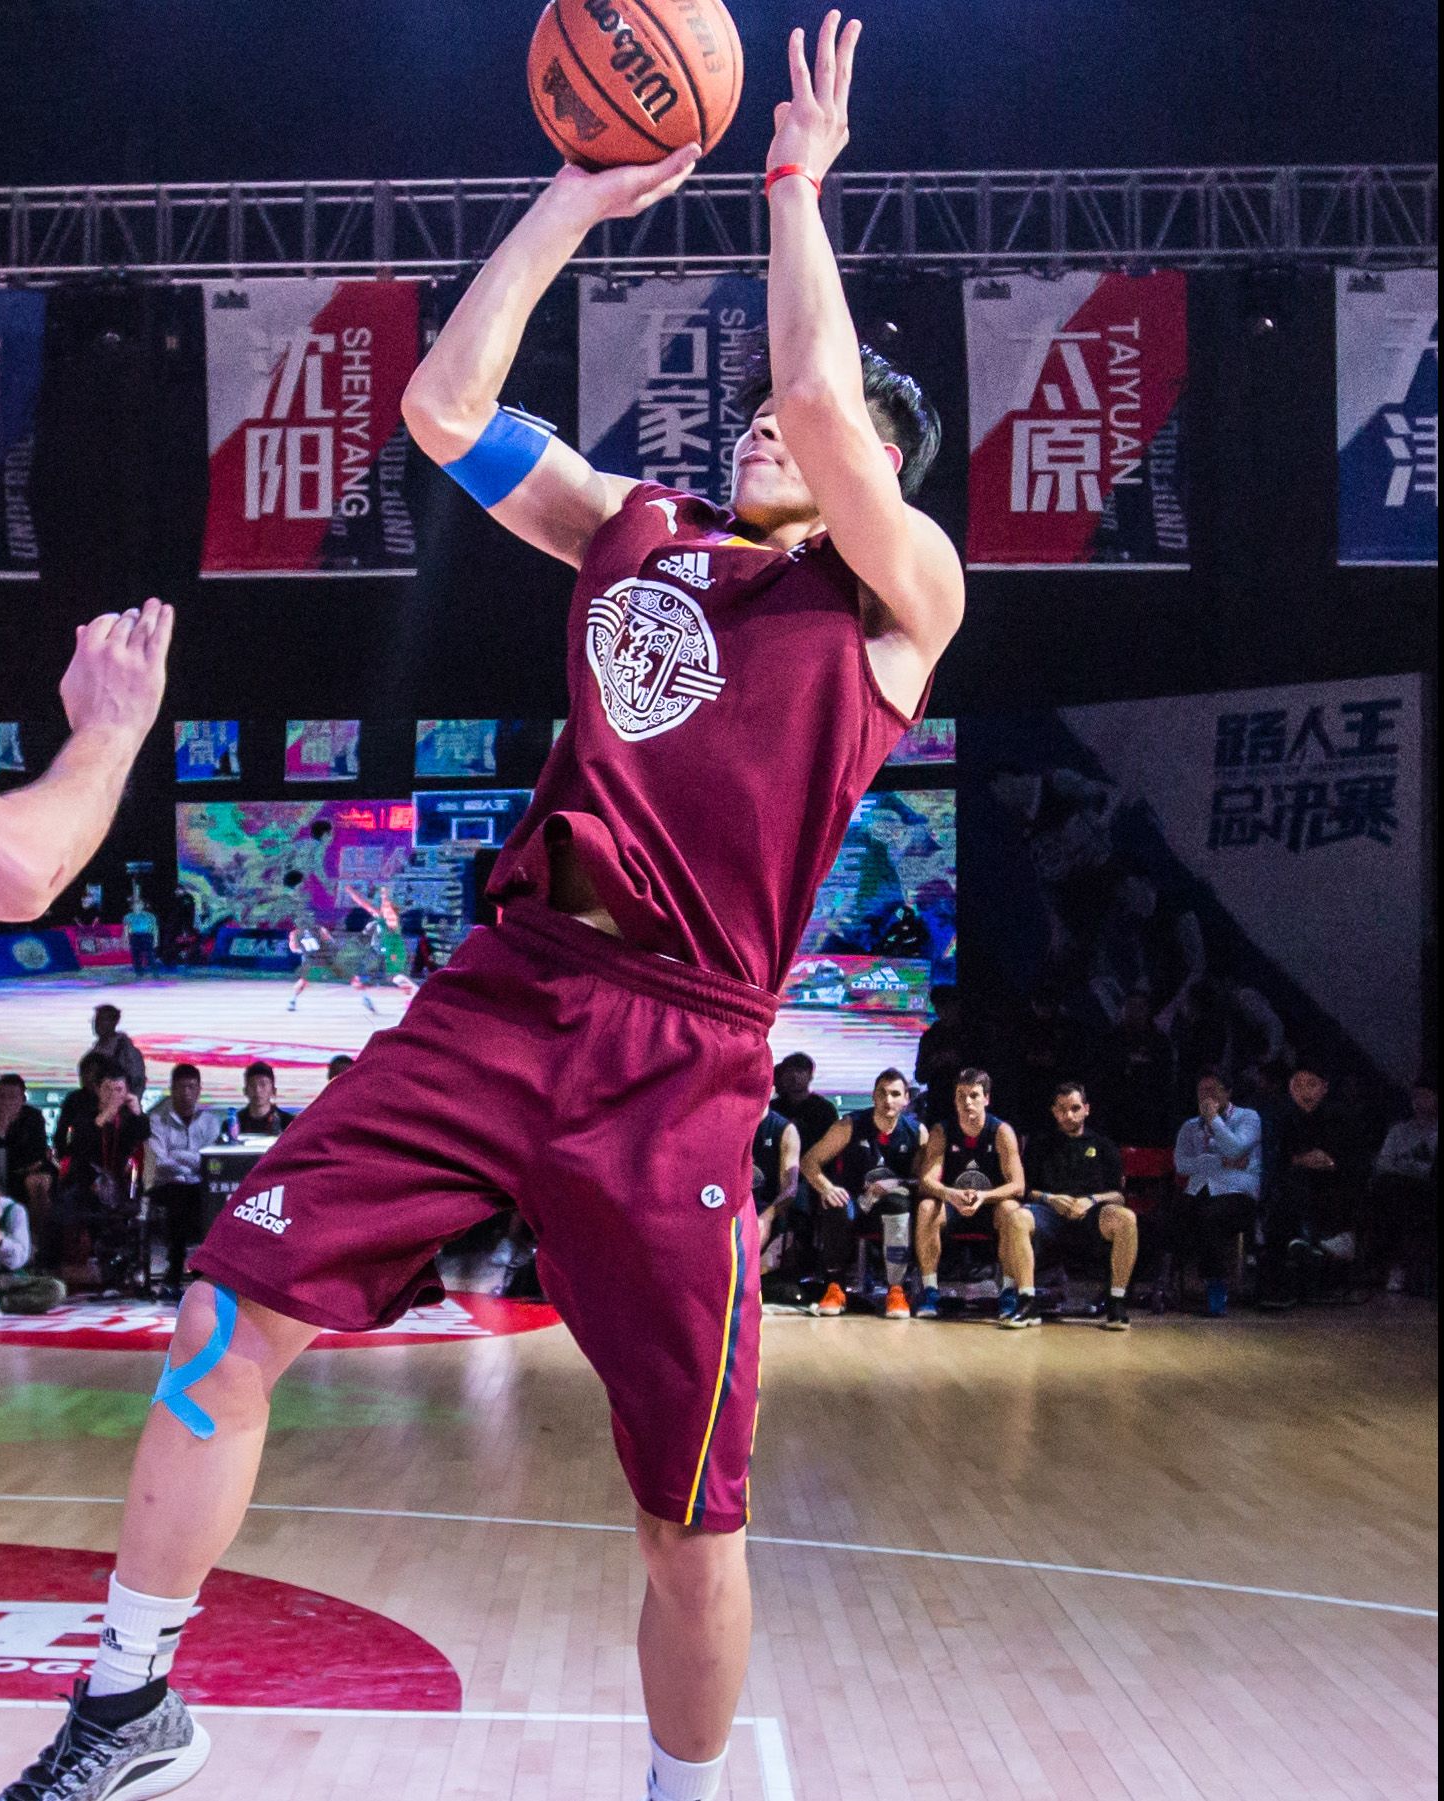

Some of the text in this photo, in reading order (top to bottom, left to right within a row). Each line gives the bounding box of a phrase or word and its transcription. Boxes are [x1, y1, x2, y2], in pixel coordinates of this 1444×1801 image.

[245, 326, 335, 520] 沈阳
[341, 327, 372, 517] SHENYANG
[1006, 318, 1104, 512] 太原
[1108, 317, 1144, 485] TAIYUAN
[657, 558, 712, 590] adidas
[1215, 698, 1402, 767] 路人王
[851, 981, 909, 991] adidas
[233, 1204, 287, 1235] adidas
